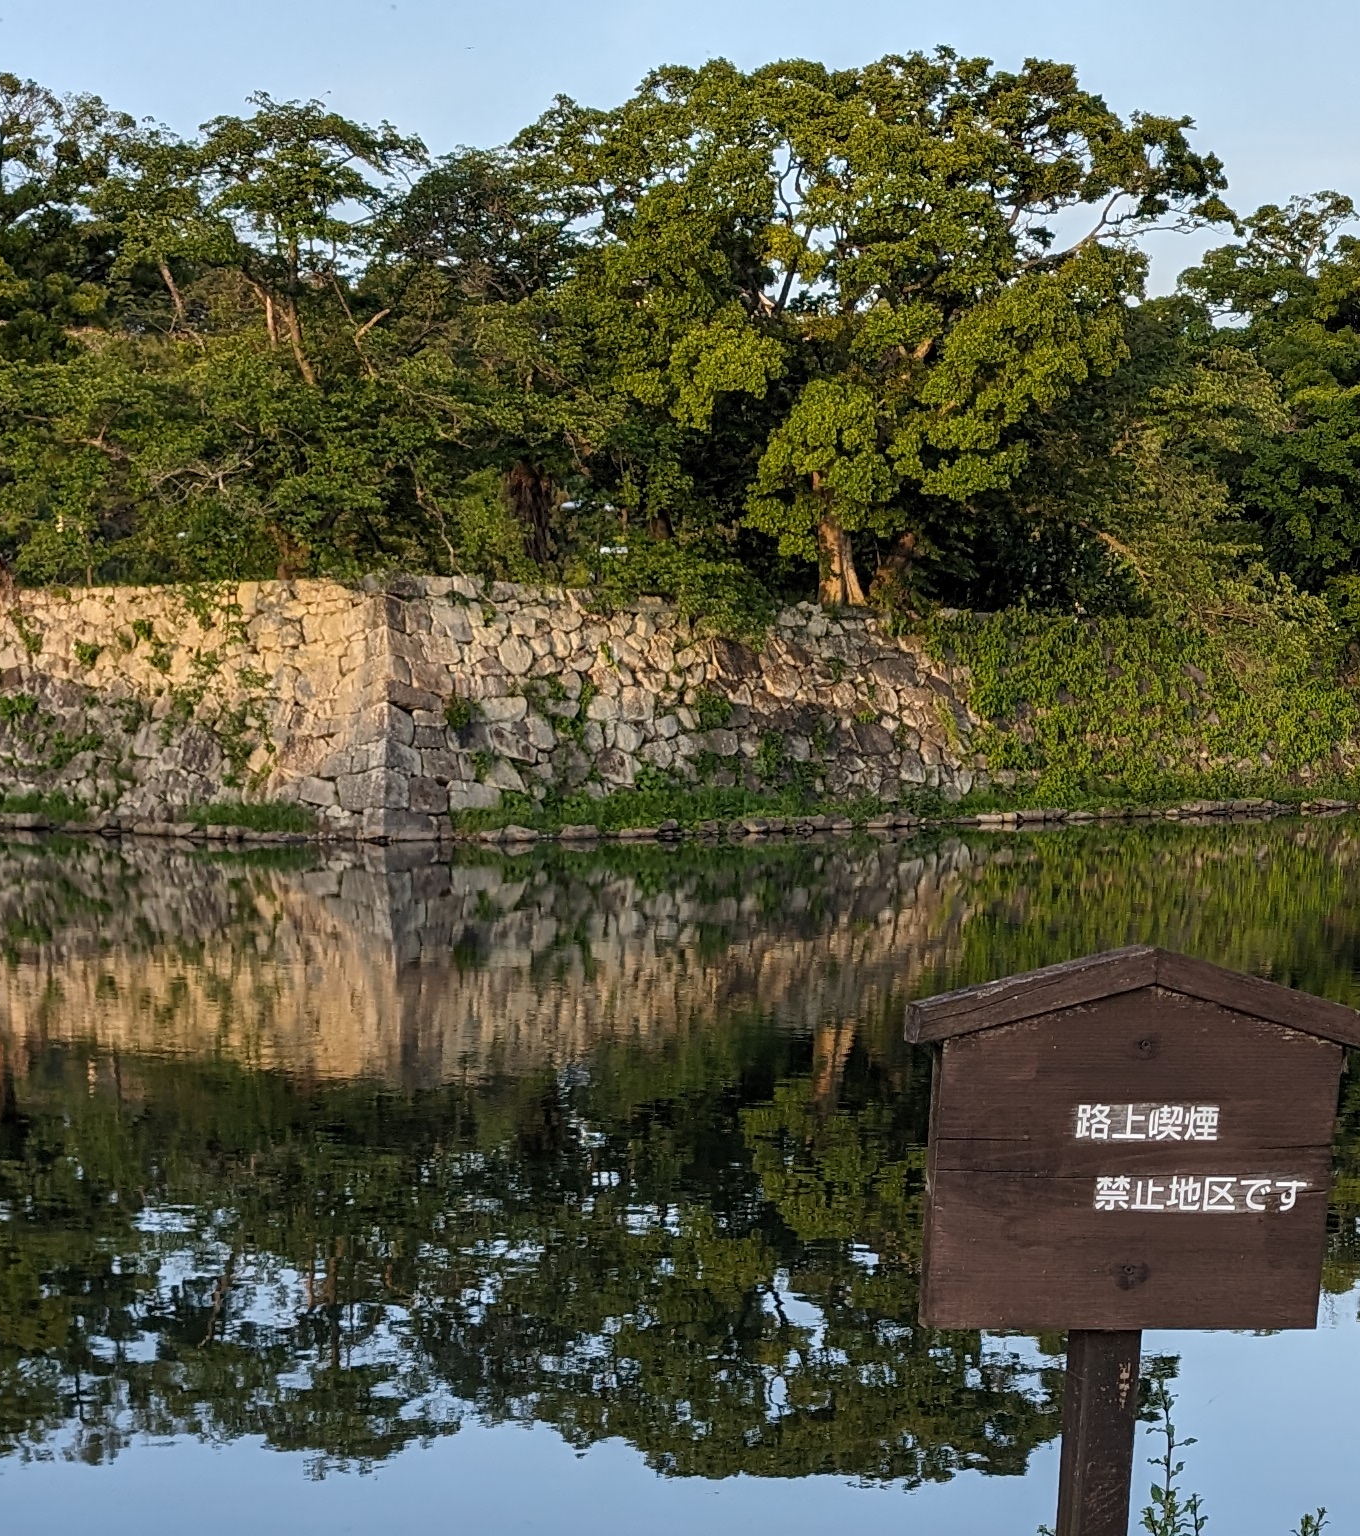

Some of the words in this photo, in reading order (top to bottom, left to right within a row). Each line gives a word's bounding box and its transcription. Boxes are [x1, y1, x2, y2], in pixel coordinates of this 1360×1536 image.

[1075, 1103, 1220, 1142] 路上喫煙
[1094, 1175, 1308, 1212] 禁止地区です
